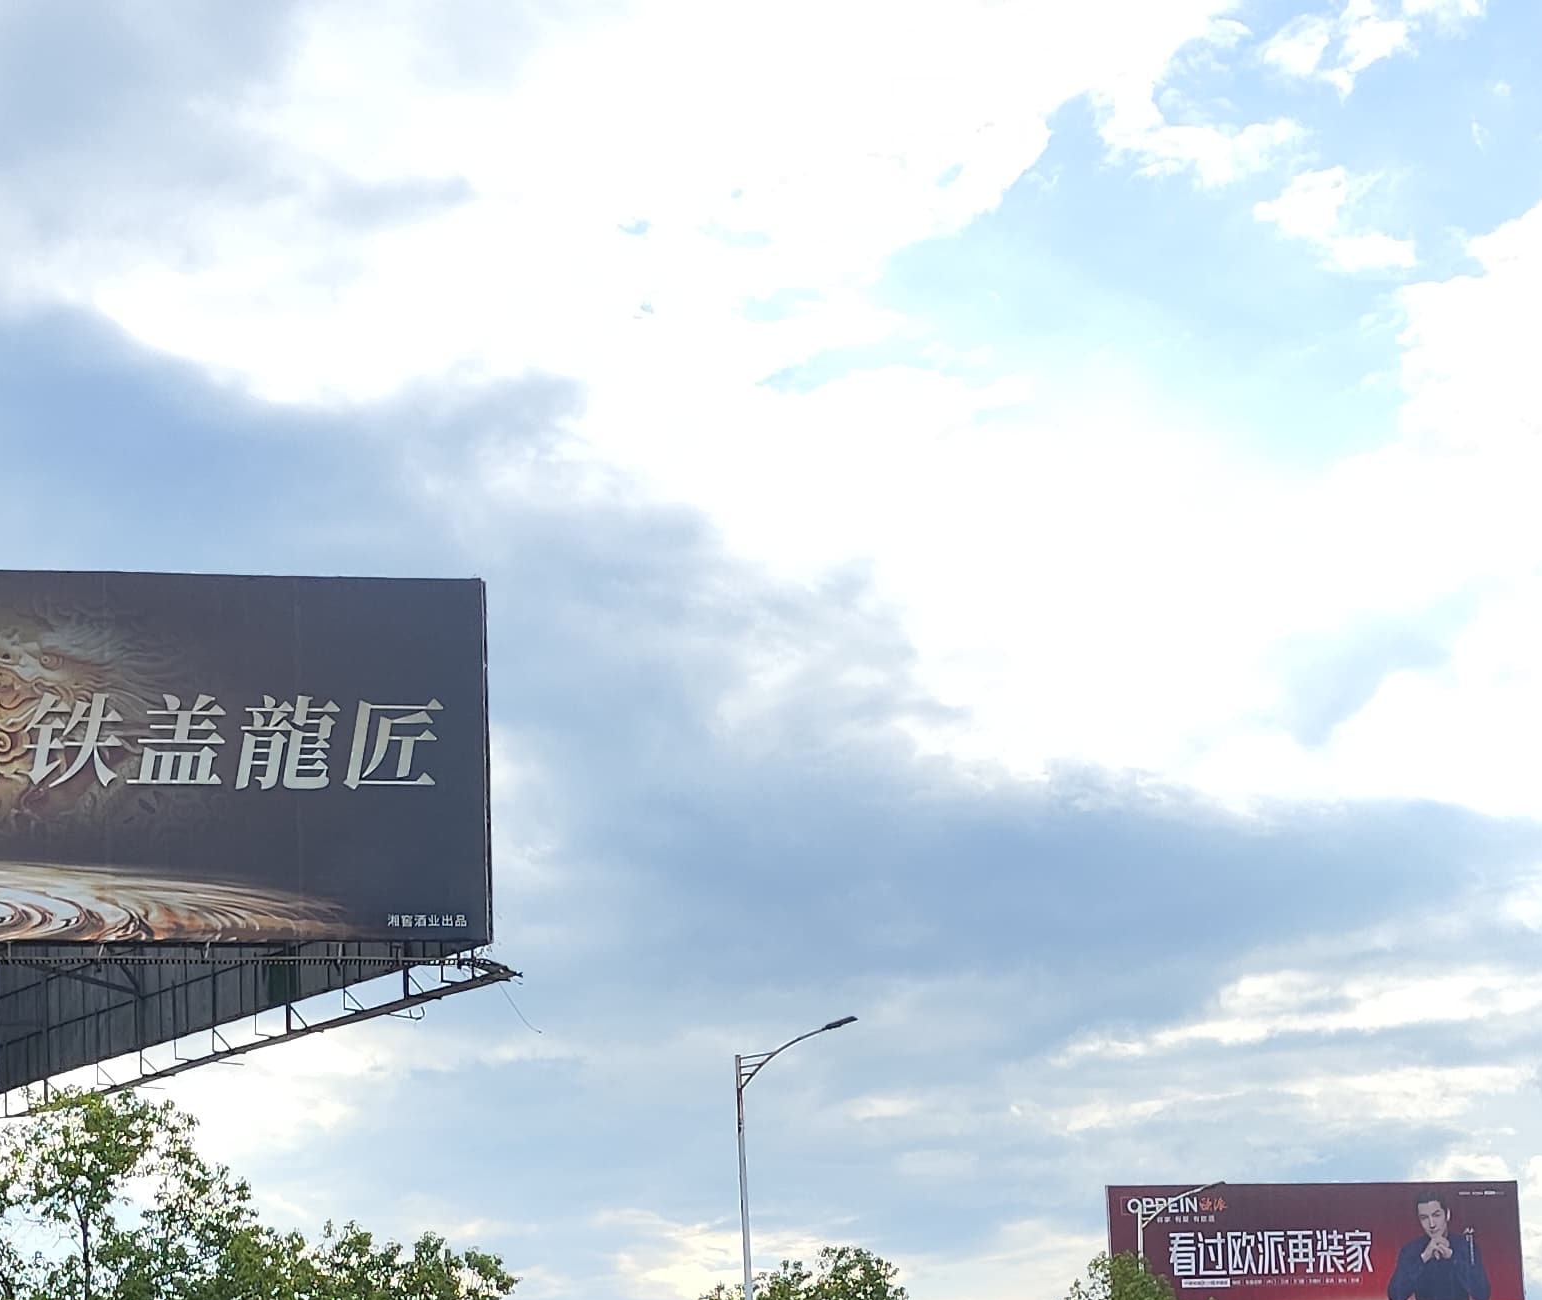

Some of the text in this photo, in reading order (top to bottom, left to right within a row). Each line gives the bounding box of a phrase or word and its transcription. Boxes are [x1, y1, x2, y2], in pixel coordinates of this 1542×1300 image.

[24, 693, 445, 792] 铁盖龍匠
[387, 913, 468, 928] 湘窖酒业出品
[1127, 1196, 1198, 1213] OPPEIN
[1168, 1229, 1374, 1277] 看过欧派再装家
